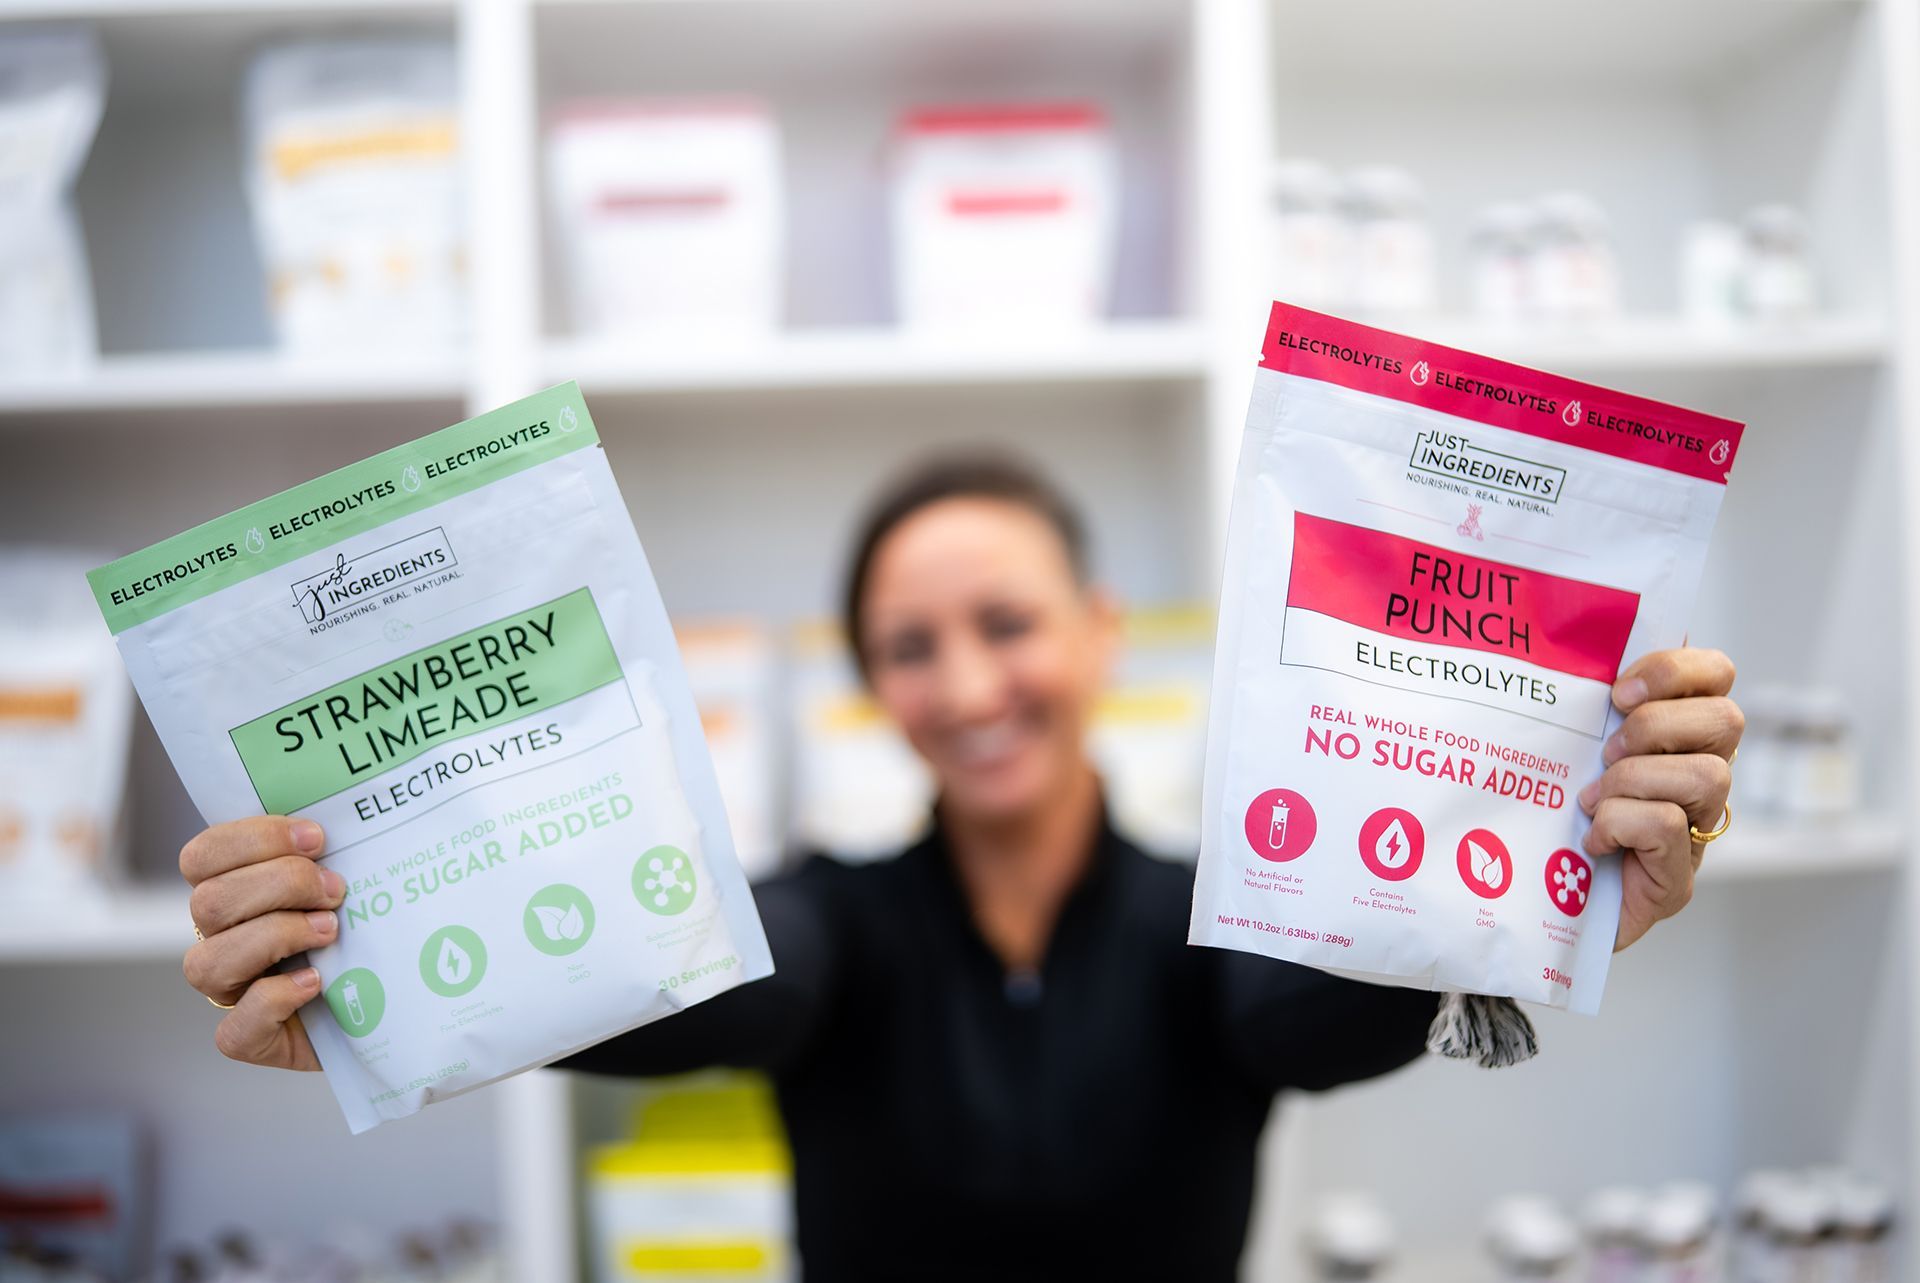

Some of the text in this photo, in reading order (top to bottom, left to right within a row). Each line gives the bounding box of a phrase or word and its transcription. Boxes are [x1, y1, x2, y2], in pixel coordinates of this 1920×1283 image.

[1278, 330, 1704, 454] ELECTROLYTES ELECTROLYTES ELECTROLYTES
[1425, 430, 1469, 453] JUST
[1406, 472, 1555, 518] NOURISHING. REAL. NATURAL.
[1420, 448, 1554, 495] INGREDIENTS
[110, 420, 551, 606] ELECTROLYTES ELECTROLYTES ELECTROLYTES
[292, 553, 354, 621] just
[309, 571, 465, 636] NOURISHING. REAL. NATURAL.
[328, 548, 446, 605] INGREDIENTS
[1410, 551, 1520, 606] FRUIT
[1385, 593, 1530, 654] PUNCH
[275, 611, 556, 753] STRAWBERRY
[1356, 641, 1557, 705] ELECTROLYTES
[338, 671, 539, 776] LIMEADE
[1310, 704, 1570, 779] REAL WHOLE FOOD INGREDIENTS
[353, 724, 563, 821] ELECTROLYTES
[1304, 726, 1565, 810] NO SUGAR ADDED
[387, 841, 447, 878] WHOLE
[451, 819, 497, 849] FOOD
[502, 772, 623, 827] INGREDIENTS
[346, 793, 634, 930] NO SUGAR ADDED
[1244, 879, 1304, 896] Natural Flavors
[1246, 868, 1304, 884] No Artificial or
[1353, 896, 1417, 915] Five Electrolytes
[1369, 887, 1404, 901] Contains
[1479, 908, 1494, 918] Non
[1217, 915, 1354, 947] Net Wt 10.2oz (.63lbs) (289g)
[1476, 918, 1496, 929] GMO
[658, 954, 737, 992] 30 Servings
[1542, 966, 1556, 981] 30
